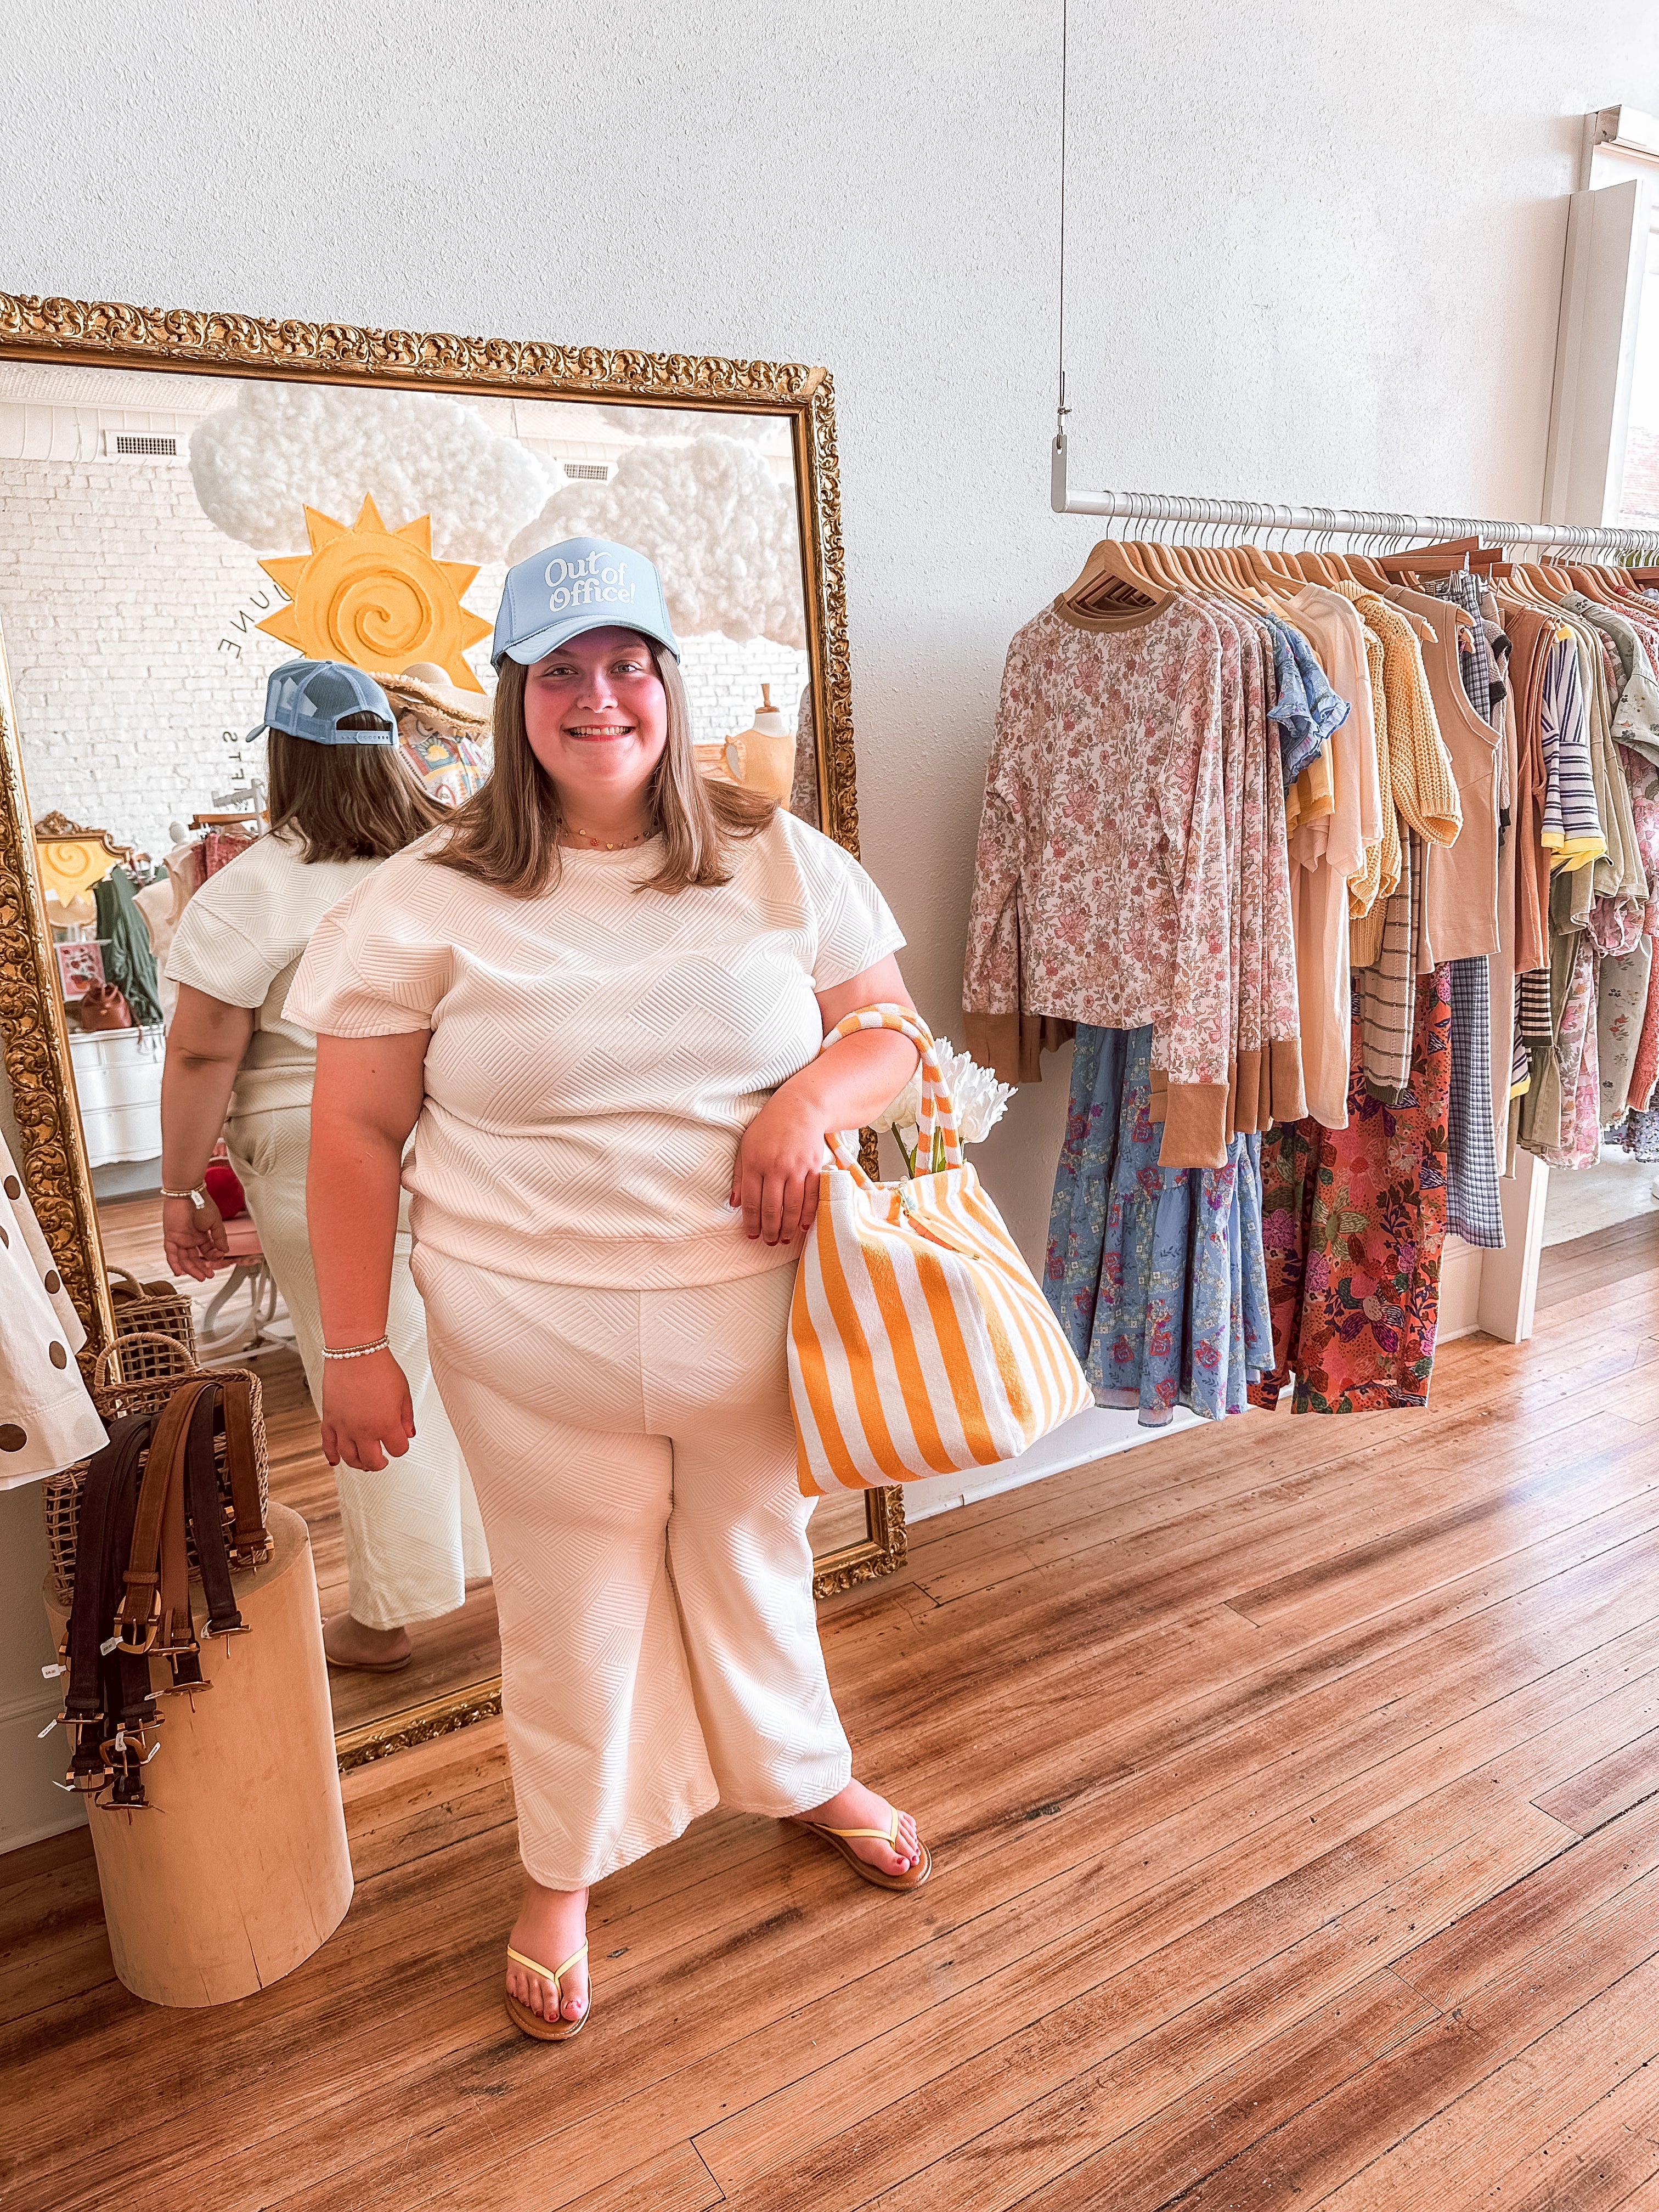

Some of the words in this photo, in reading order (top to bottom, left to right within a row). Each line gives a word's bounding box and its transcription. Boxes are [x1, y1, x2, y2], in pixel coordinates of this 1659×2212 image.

[544, 550, 612, 587] Out
[601, 562, 628, 586] of
[549, 578, 636, 612] Office!
